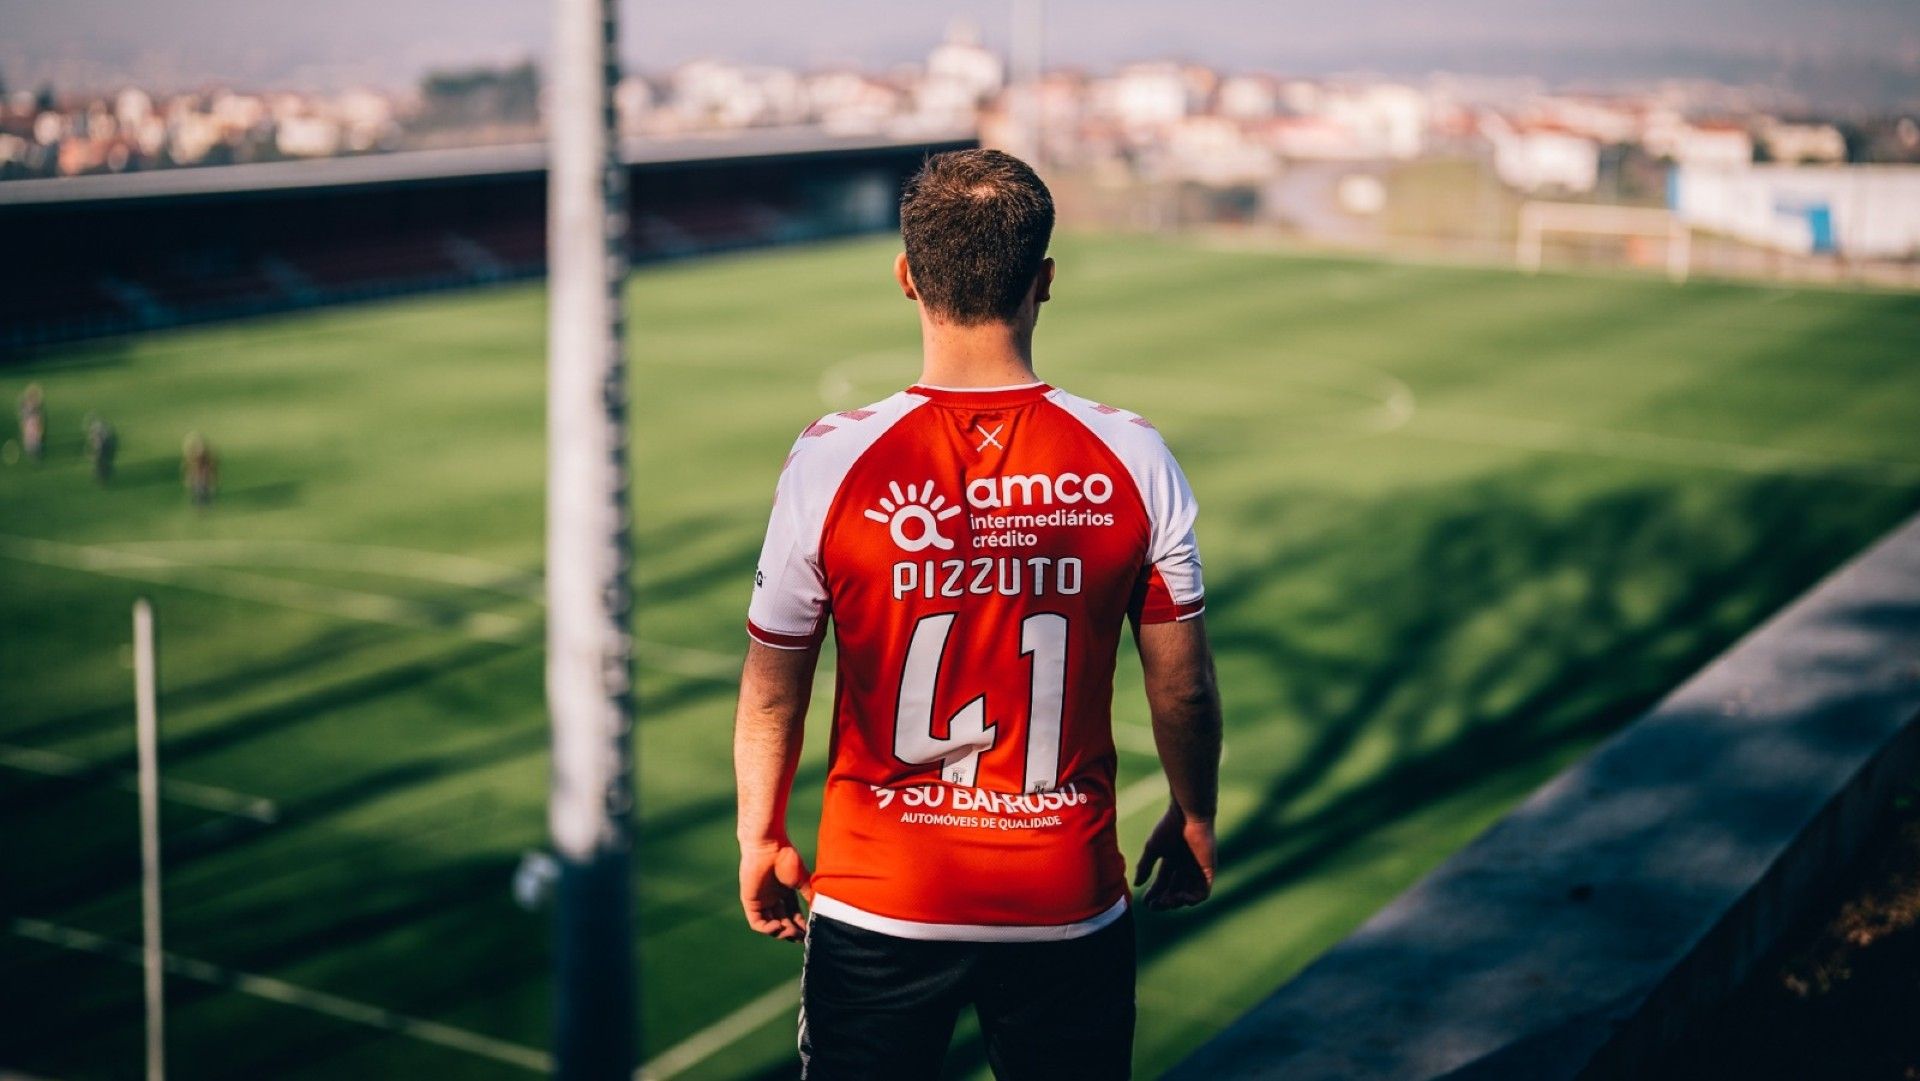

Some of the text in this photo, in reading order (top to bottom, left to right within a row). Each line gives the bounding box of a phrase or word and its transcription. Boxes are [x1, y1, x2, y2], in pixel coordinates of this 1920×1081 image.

[966, 472, 1113, 509] amco
[970, 509, 1114, 530] intermediários
[973, 531, 1038, 548] crédito
[892, 557, 1083, 600] PIZZUTO
[893, 611, 1068, 794] 41
[901, 812, 1063, 831] AUTOMÓVEIS DE QUALIDADE
